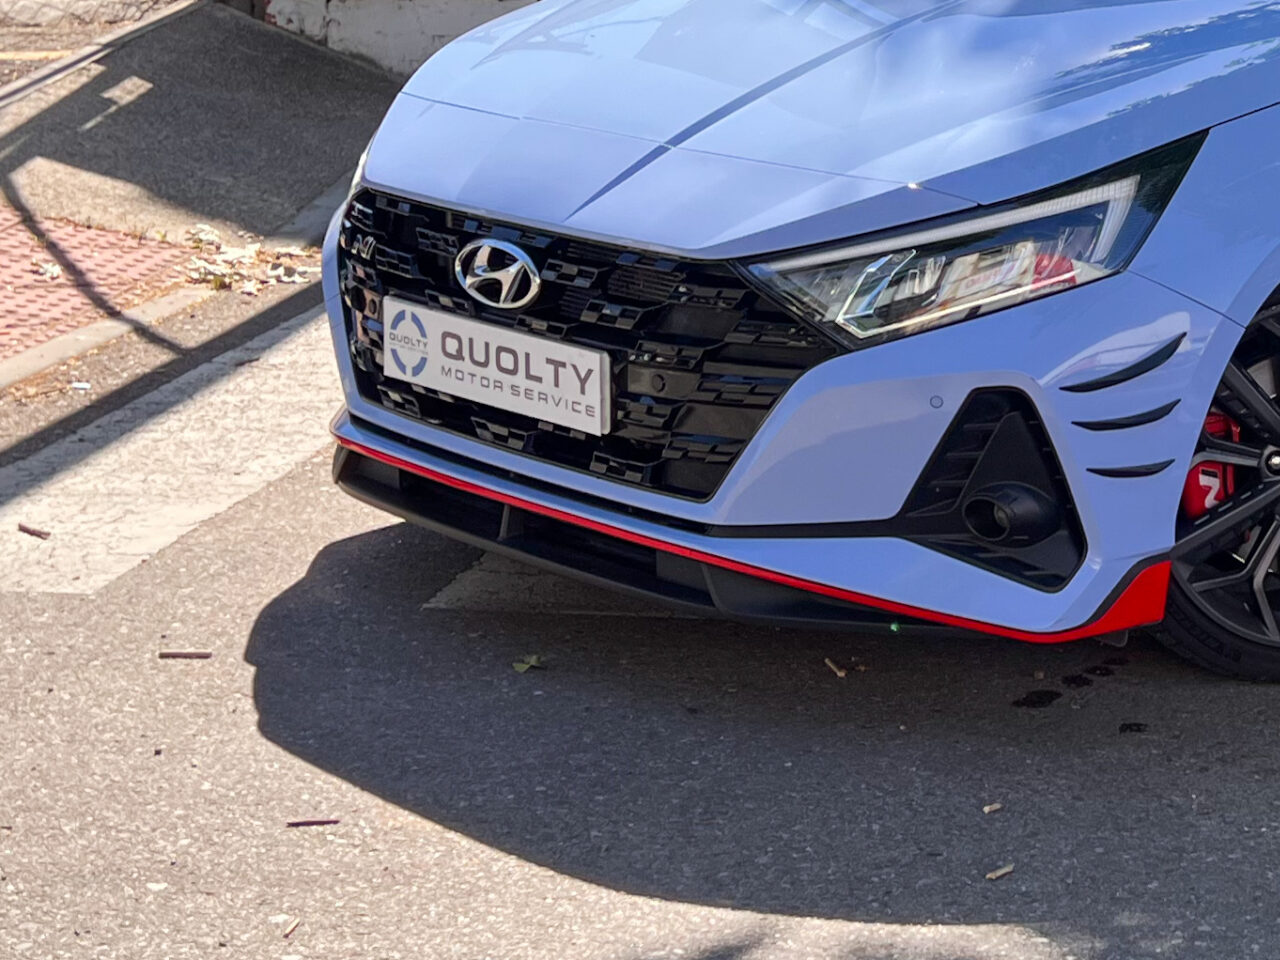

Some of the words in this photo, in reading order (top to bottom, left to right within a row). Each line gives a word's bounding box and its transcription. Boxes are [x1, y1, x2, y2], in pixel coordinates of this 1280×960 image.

[441, 331, 594, 395] QUOLTY
[441, 365, 503, 392] MOTOR
[511, 384, 595, 418] SERVICE
